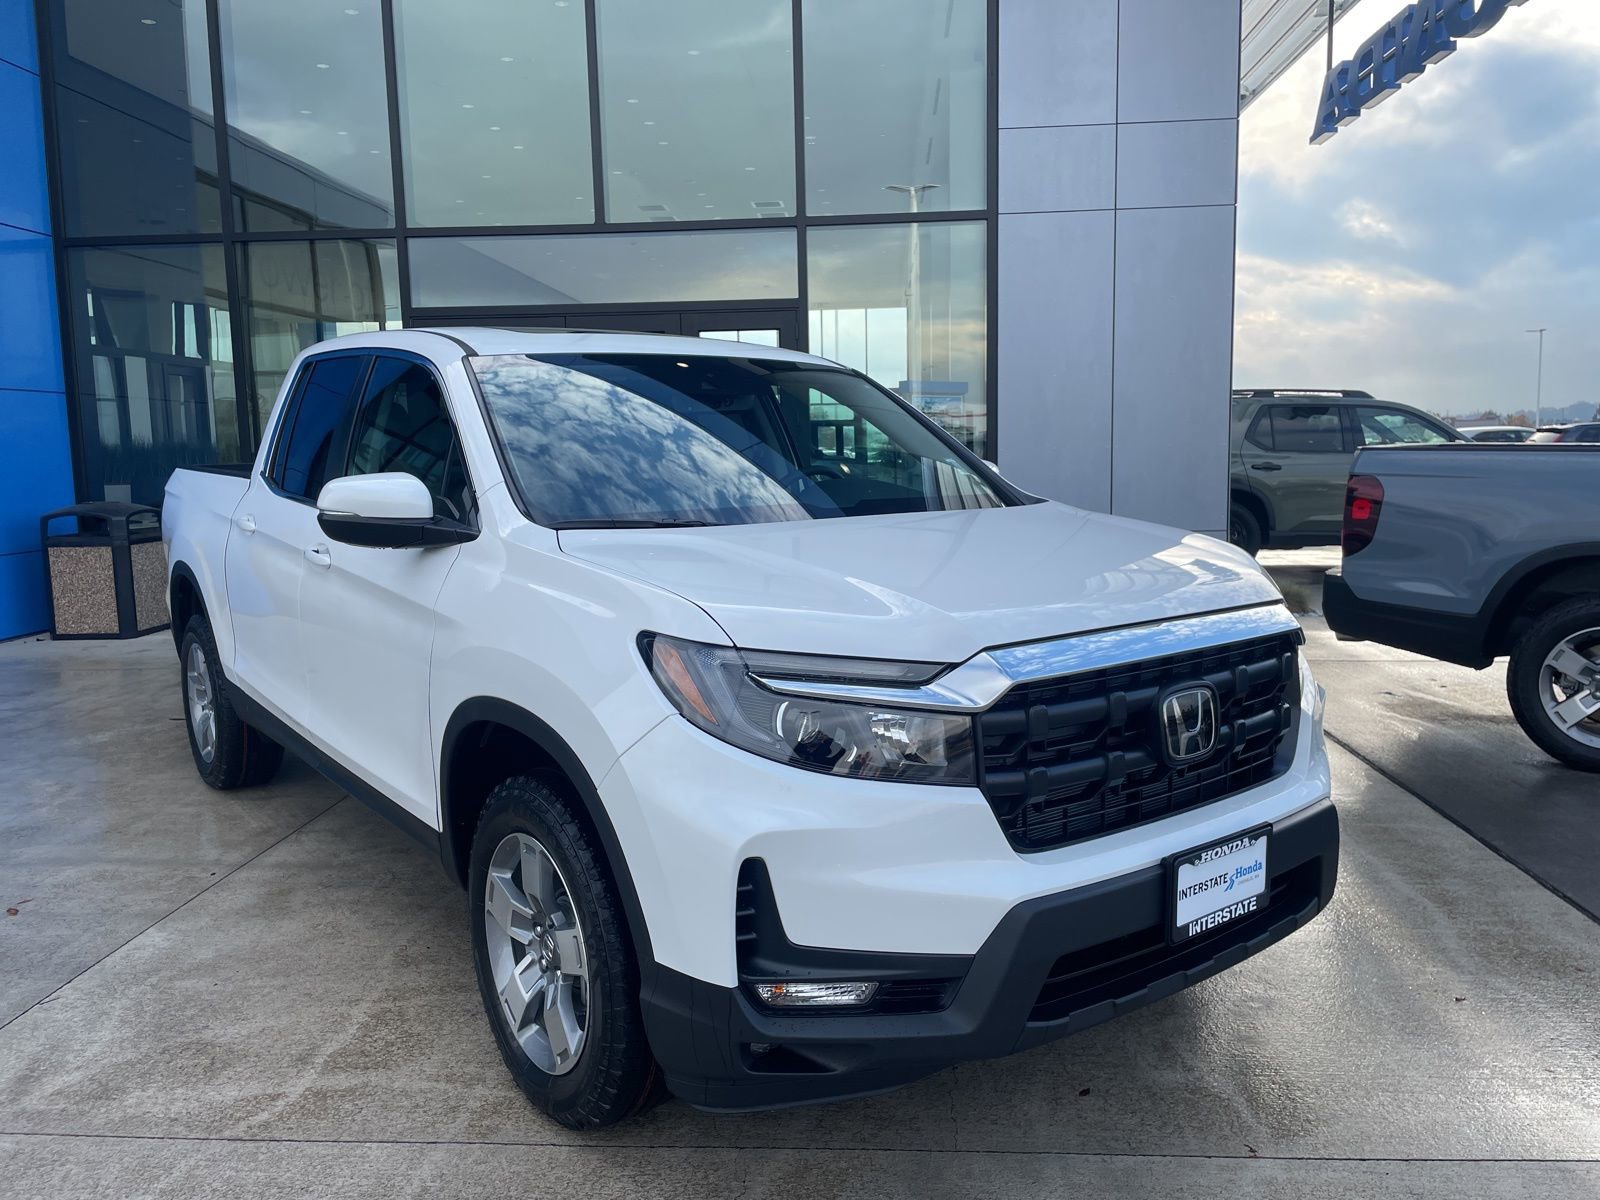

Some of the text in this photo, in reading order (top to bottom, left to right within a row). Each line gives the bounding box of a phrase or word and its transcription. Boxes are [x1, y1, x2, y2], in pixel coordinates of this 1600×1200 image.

[1200, 837, 1250, 864] HONDA
[1178, 872, 1229, 901] INTERSTATE
[1235, 859, 1263, 879] Honda
[1188, 896, 1257, 937] INTERSTATE
